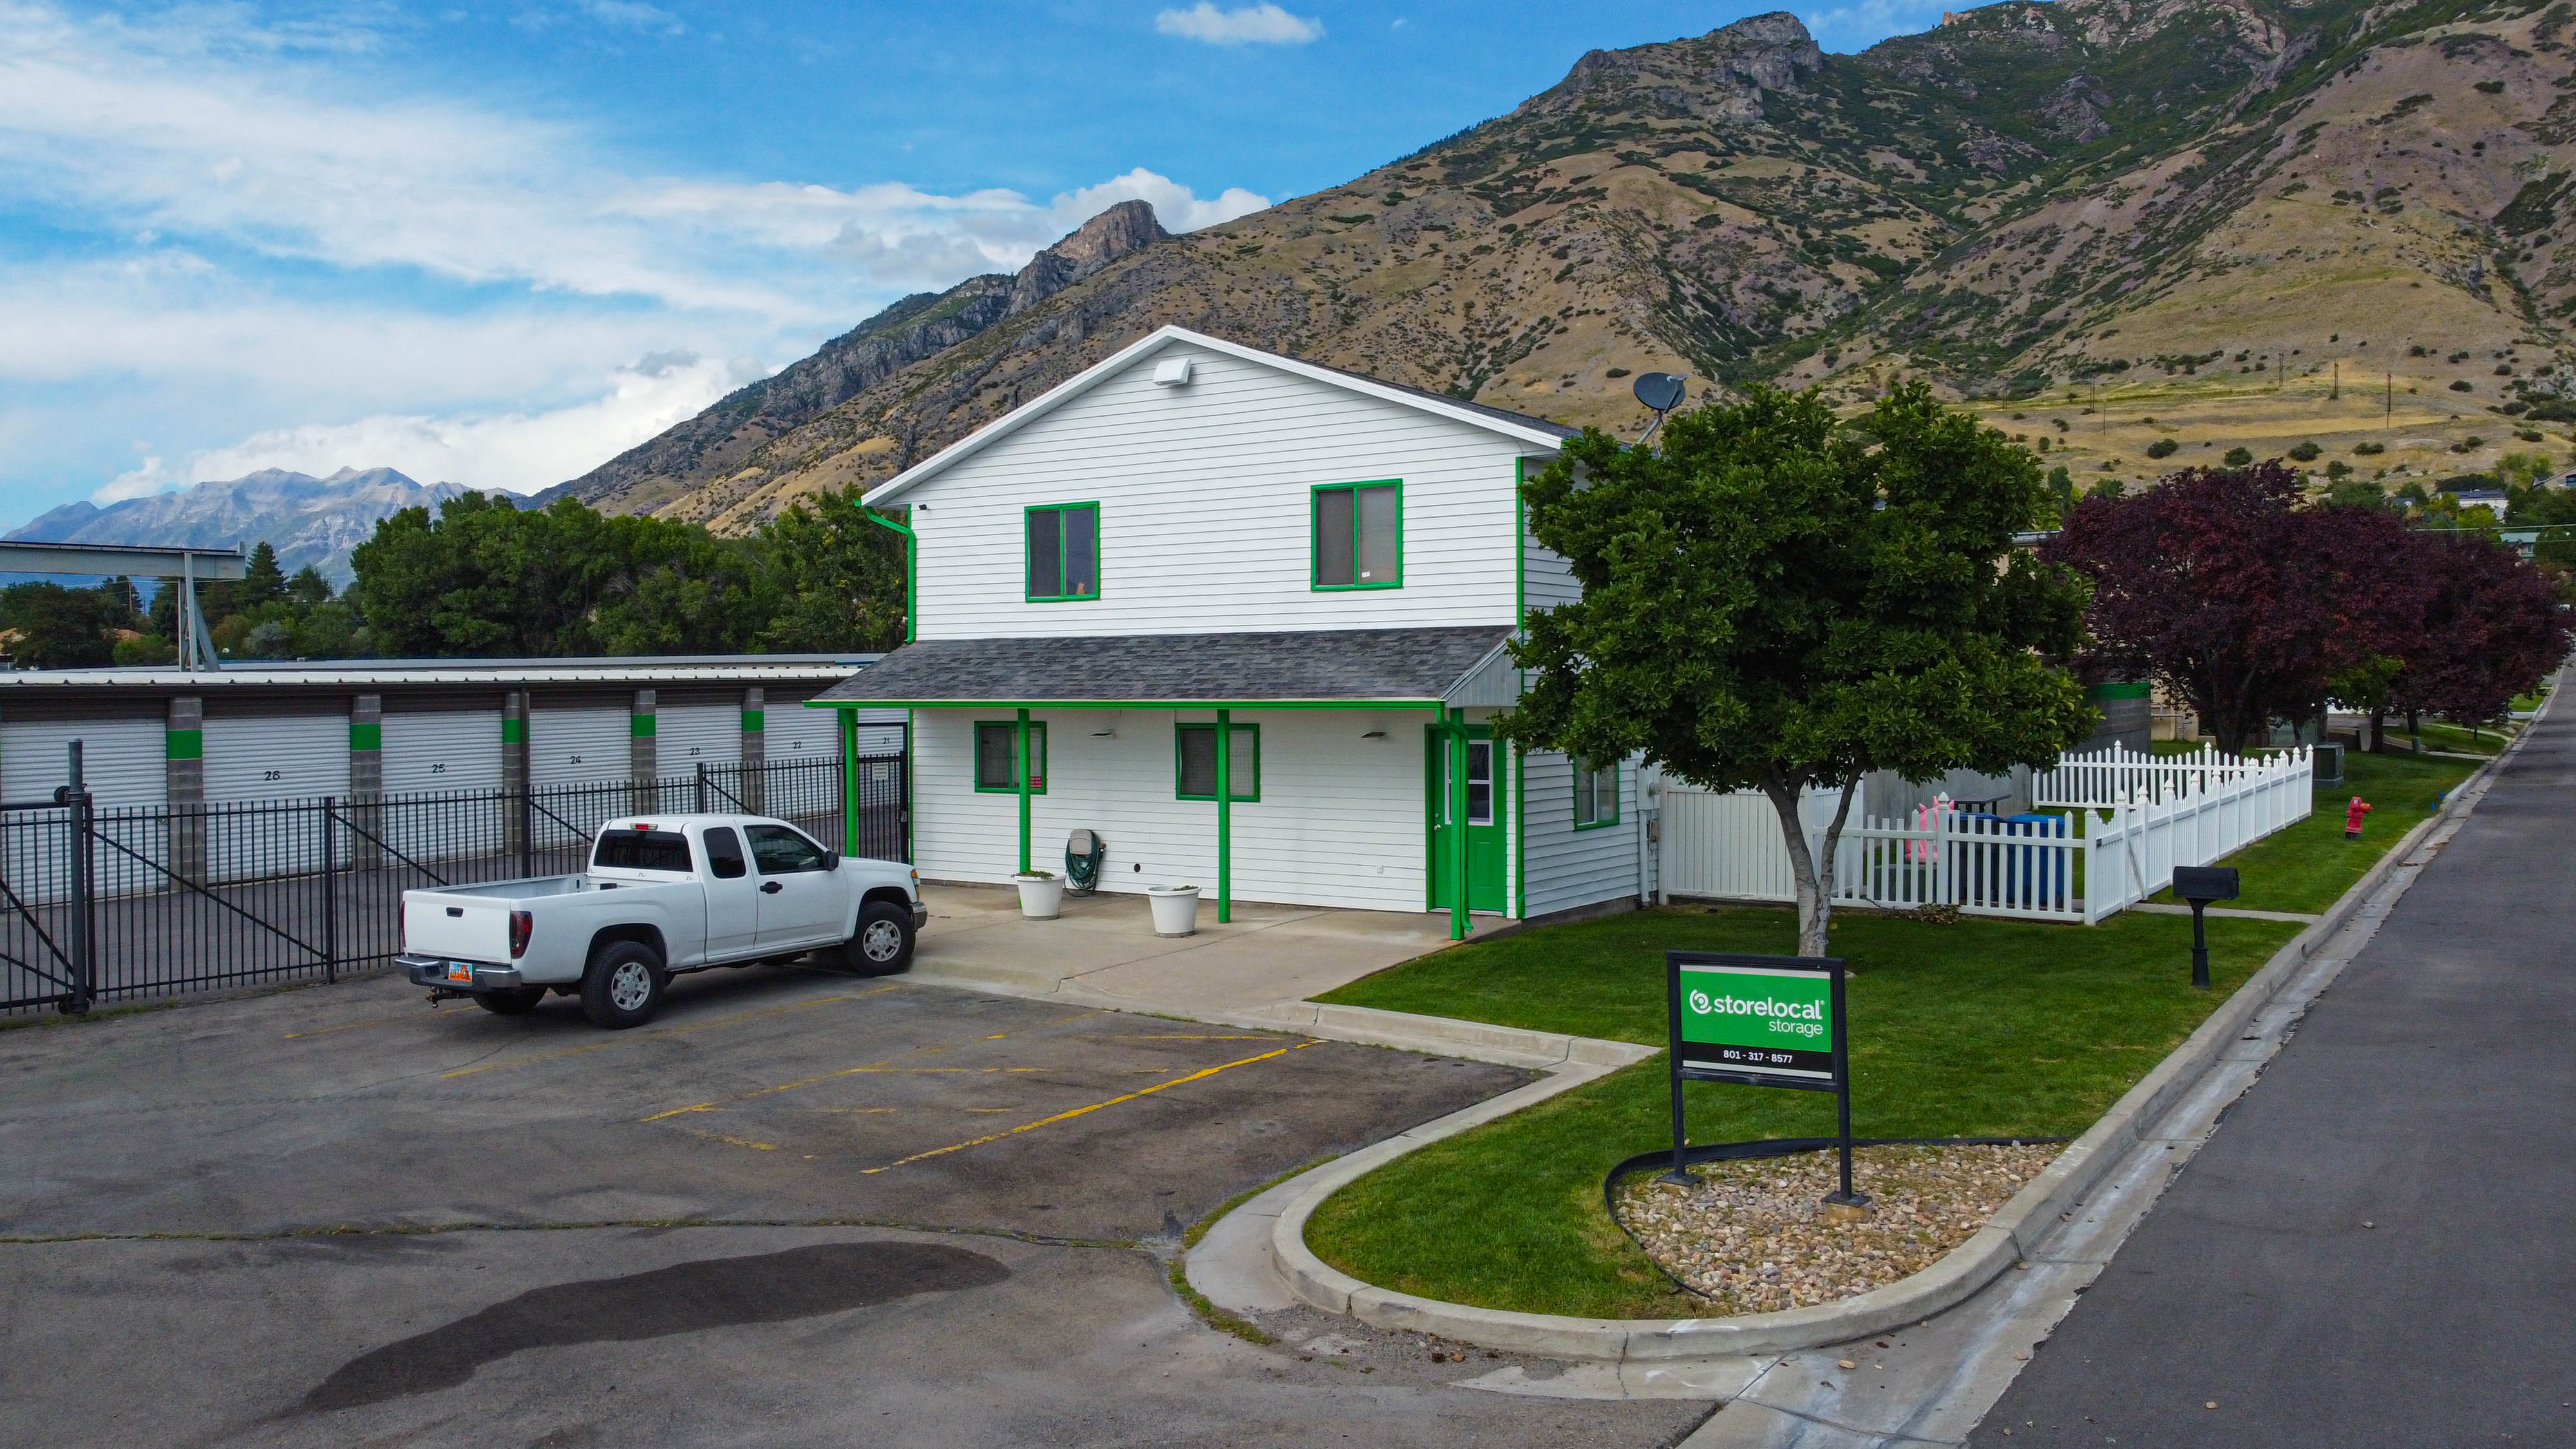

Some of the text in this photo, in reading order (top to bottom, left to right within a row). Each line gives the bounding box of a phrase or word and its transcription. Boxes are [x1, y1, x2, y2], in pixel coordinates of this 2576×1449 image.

[690, 747, 700, 755] 23
[571, 755, 582, 764] 24
[432, 764, 446, 773] 25
[264, 770, 281, 781] 26
[1714, 995, 1823, 1020] storelocal
[1768, 1019, 1823, 1037] storage
[1723, 1050, 1741, 1059] 801
[1748, 1052, 1763, 1061] 317
[1771, 1054, 1793, 1064] 8577
